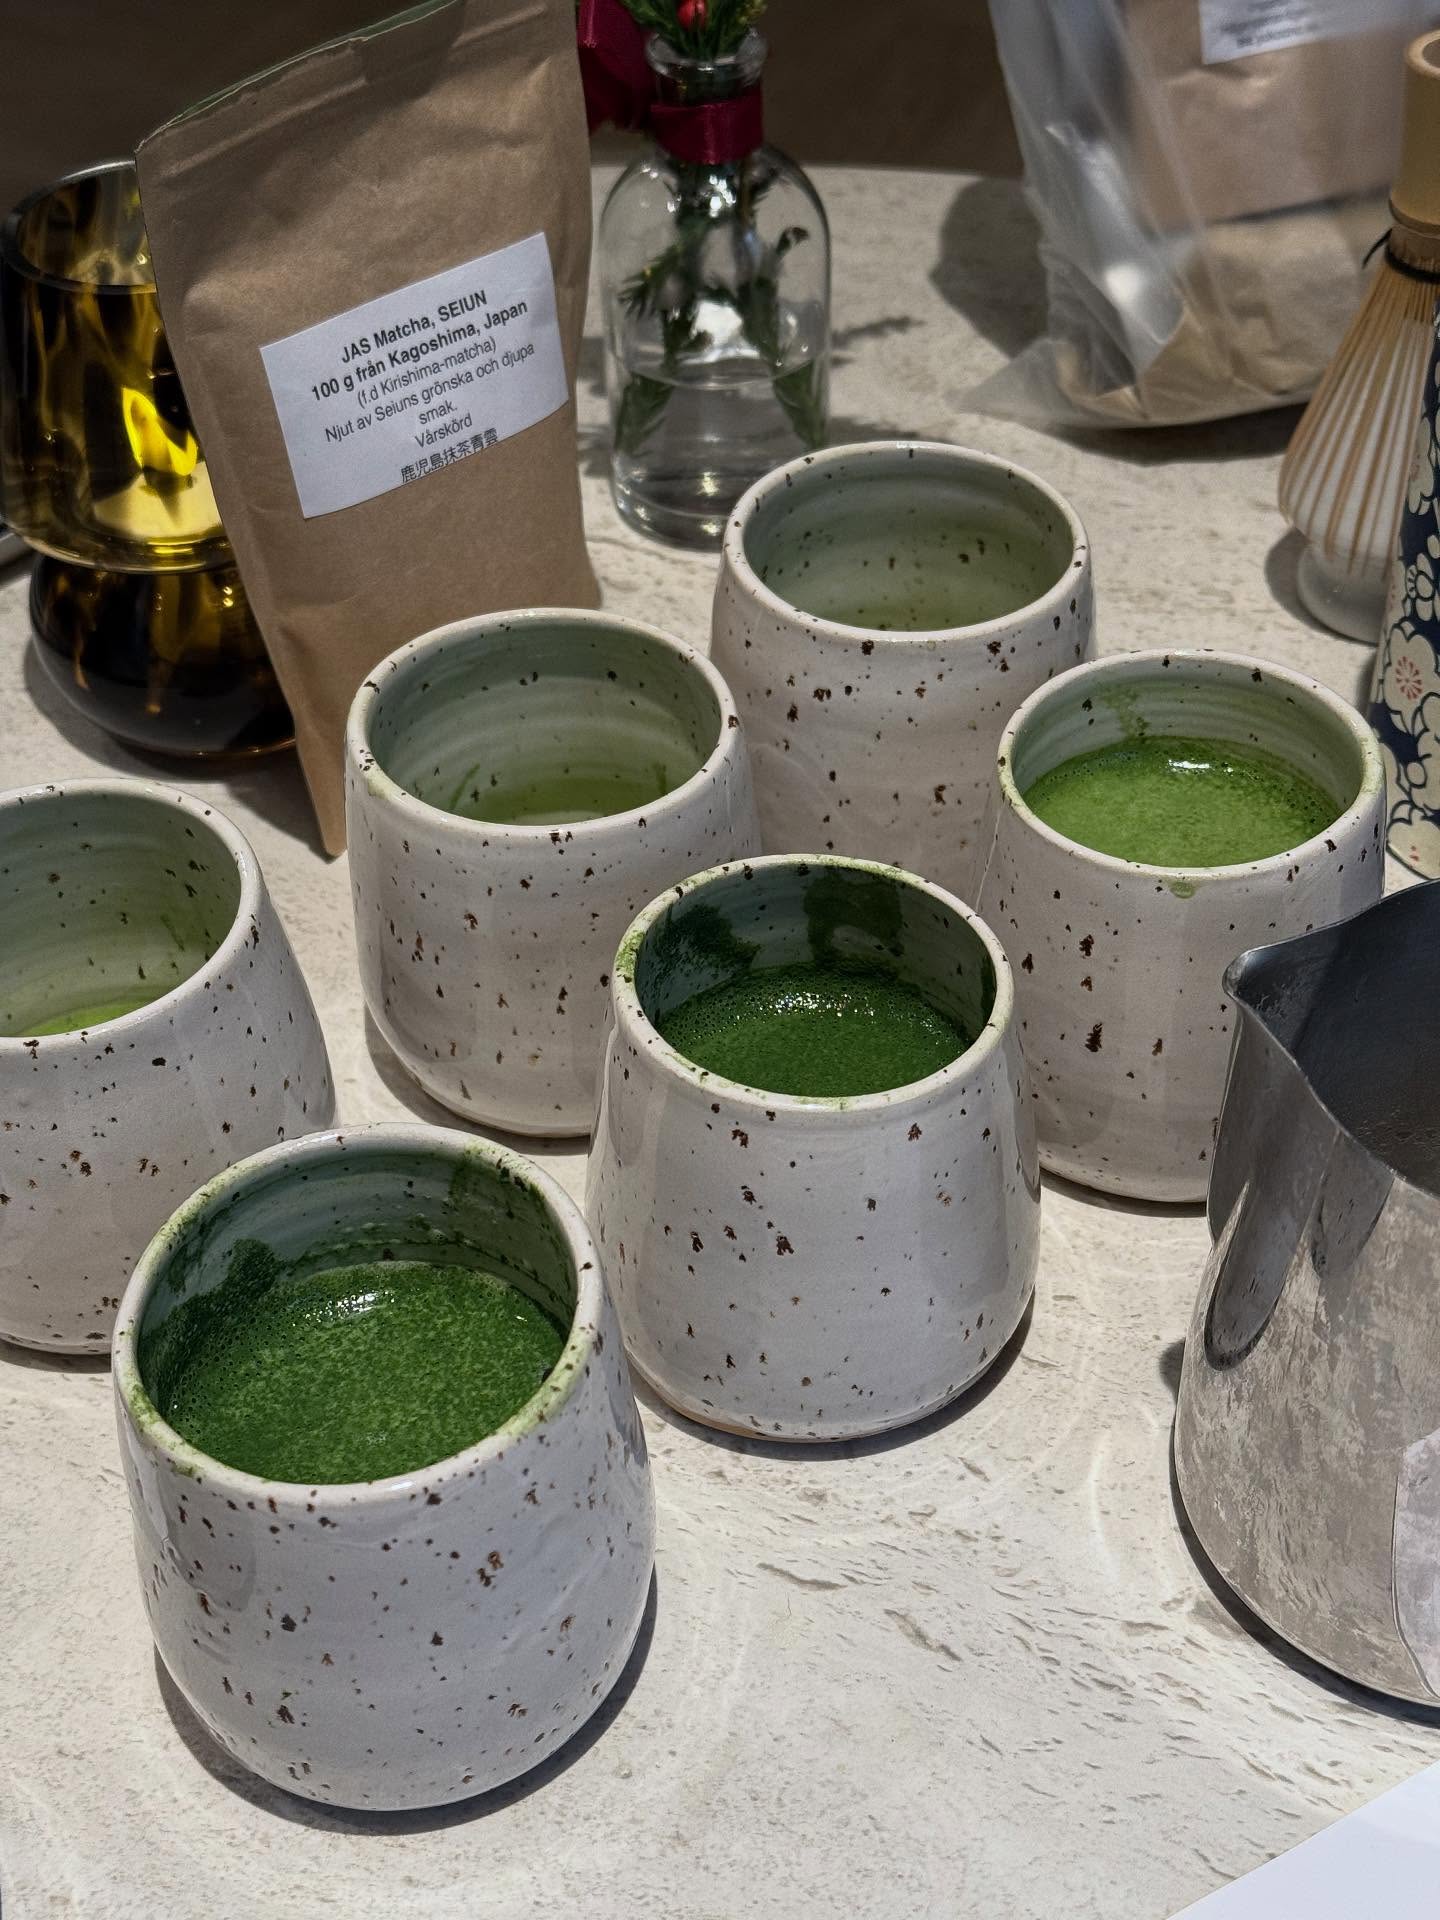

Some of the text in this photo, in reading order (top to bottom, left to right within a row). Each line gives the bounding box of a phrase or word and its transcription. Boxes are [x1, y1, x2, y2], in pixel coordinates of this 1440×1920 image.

[312, 300, 527, 401] 100 g från Kagoshima, Japan
[341, 290, 487, 364] JAS Matcha, SEIUN
[325, 344, 534, 442] Njut av Seiuns grönska och djupa
[357, 337, 496, 409] (f.d Kirishima-matcha)
[415, 414, 473, 448] Vårskörd
[419, 404, 457, 425] smak.
[401, 428, 498, 483] 鹿児島抹茶青雲
